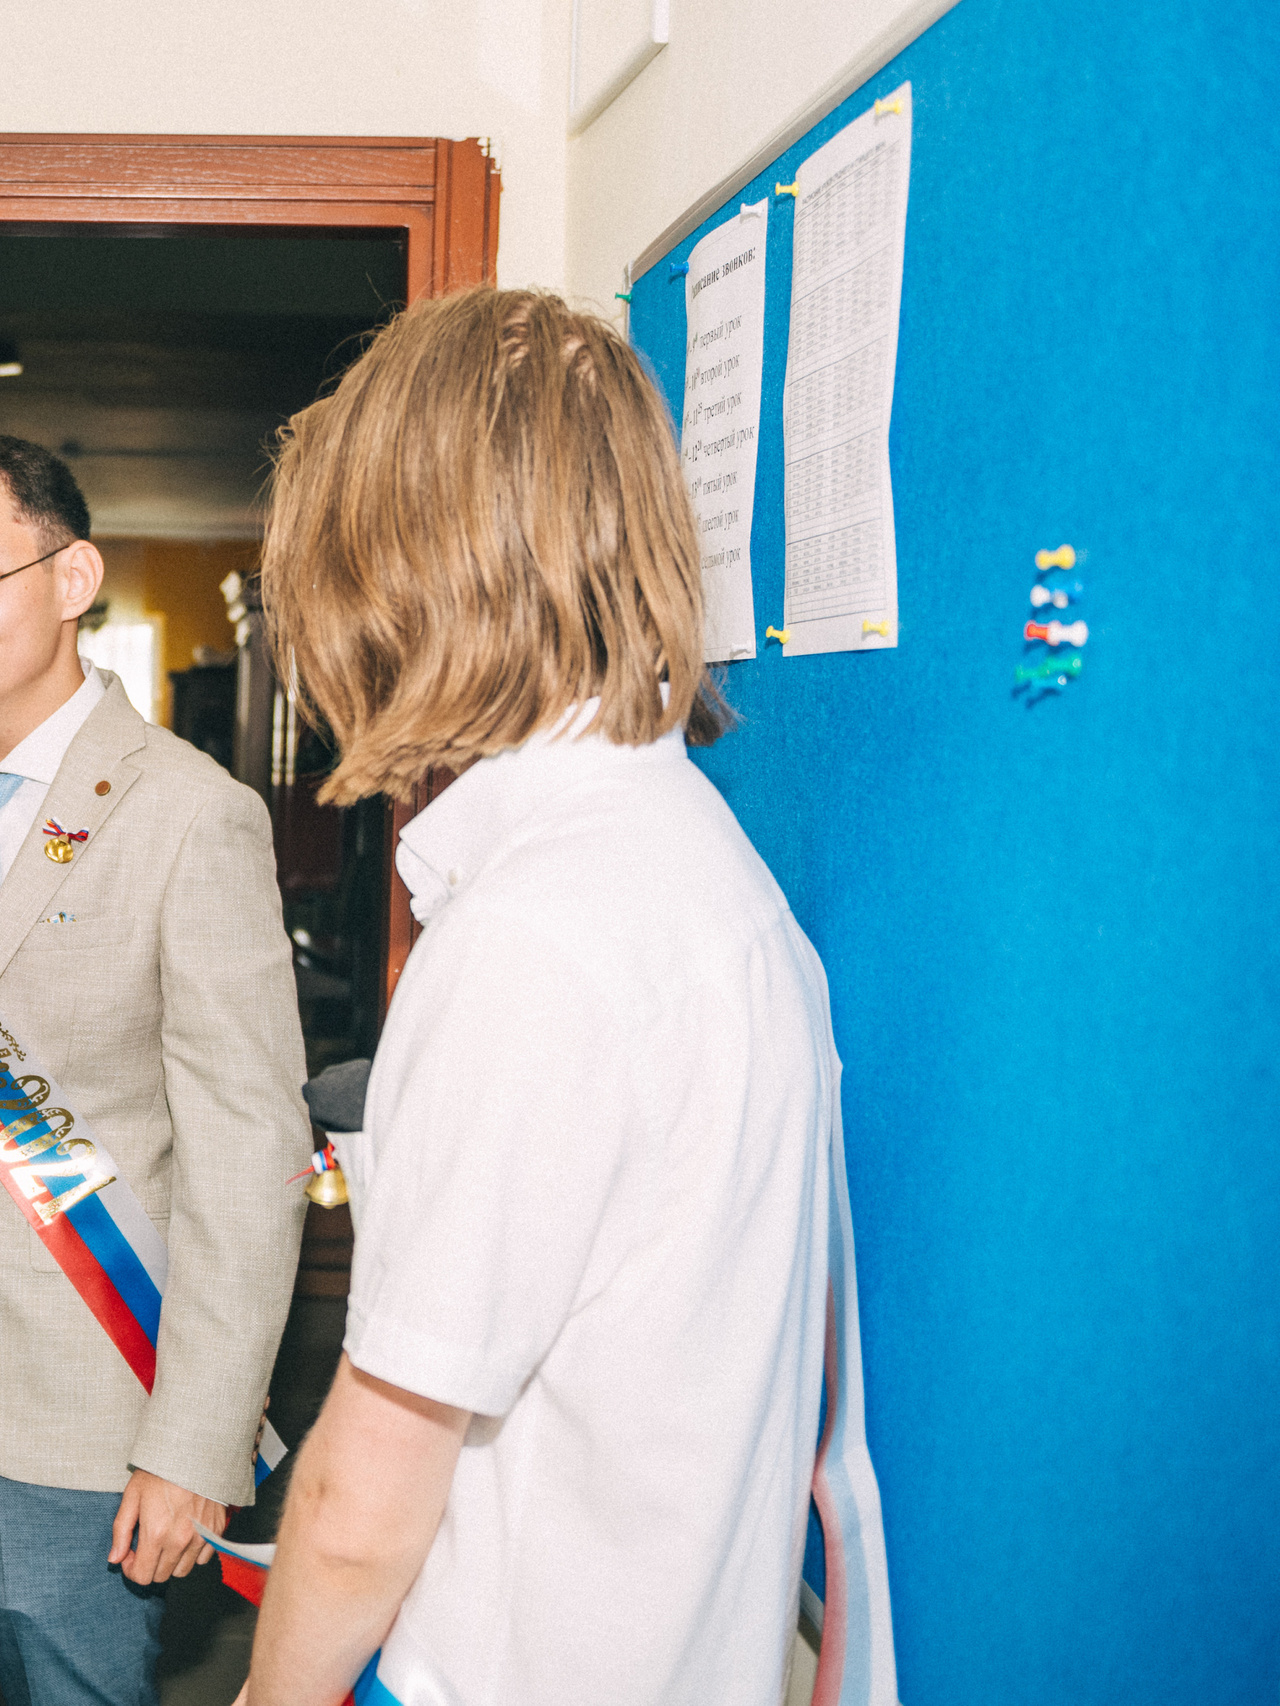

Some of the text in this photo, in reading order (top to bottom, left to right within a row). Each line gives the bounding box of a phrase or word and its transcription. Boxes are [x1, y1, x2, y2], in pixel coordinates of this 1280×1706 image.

[722, 246, 756, 278] звонков:
[699, 320, 723, 350] первый
[724, 315, 742, 340] урок
[700, 358, 723, 385] второй
[723, 354, 740, 379] урок
[703, 395, 726, 425] третий
[726, 392, 742, 415] урок
[736, 426, 755, 449] урок
[702, 473, 722, 496] пятый
[722, 471, 737, 494] урок
[702, 509, 723, 533] шестой
[723, 509, 739, 531] урок
[725, 547, 741, 569] урок
